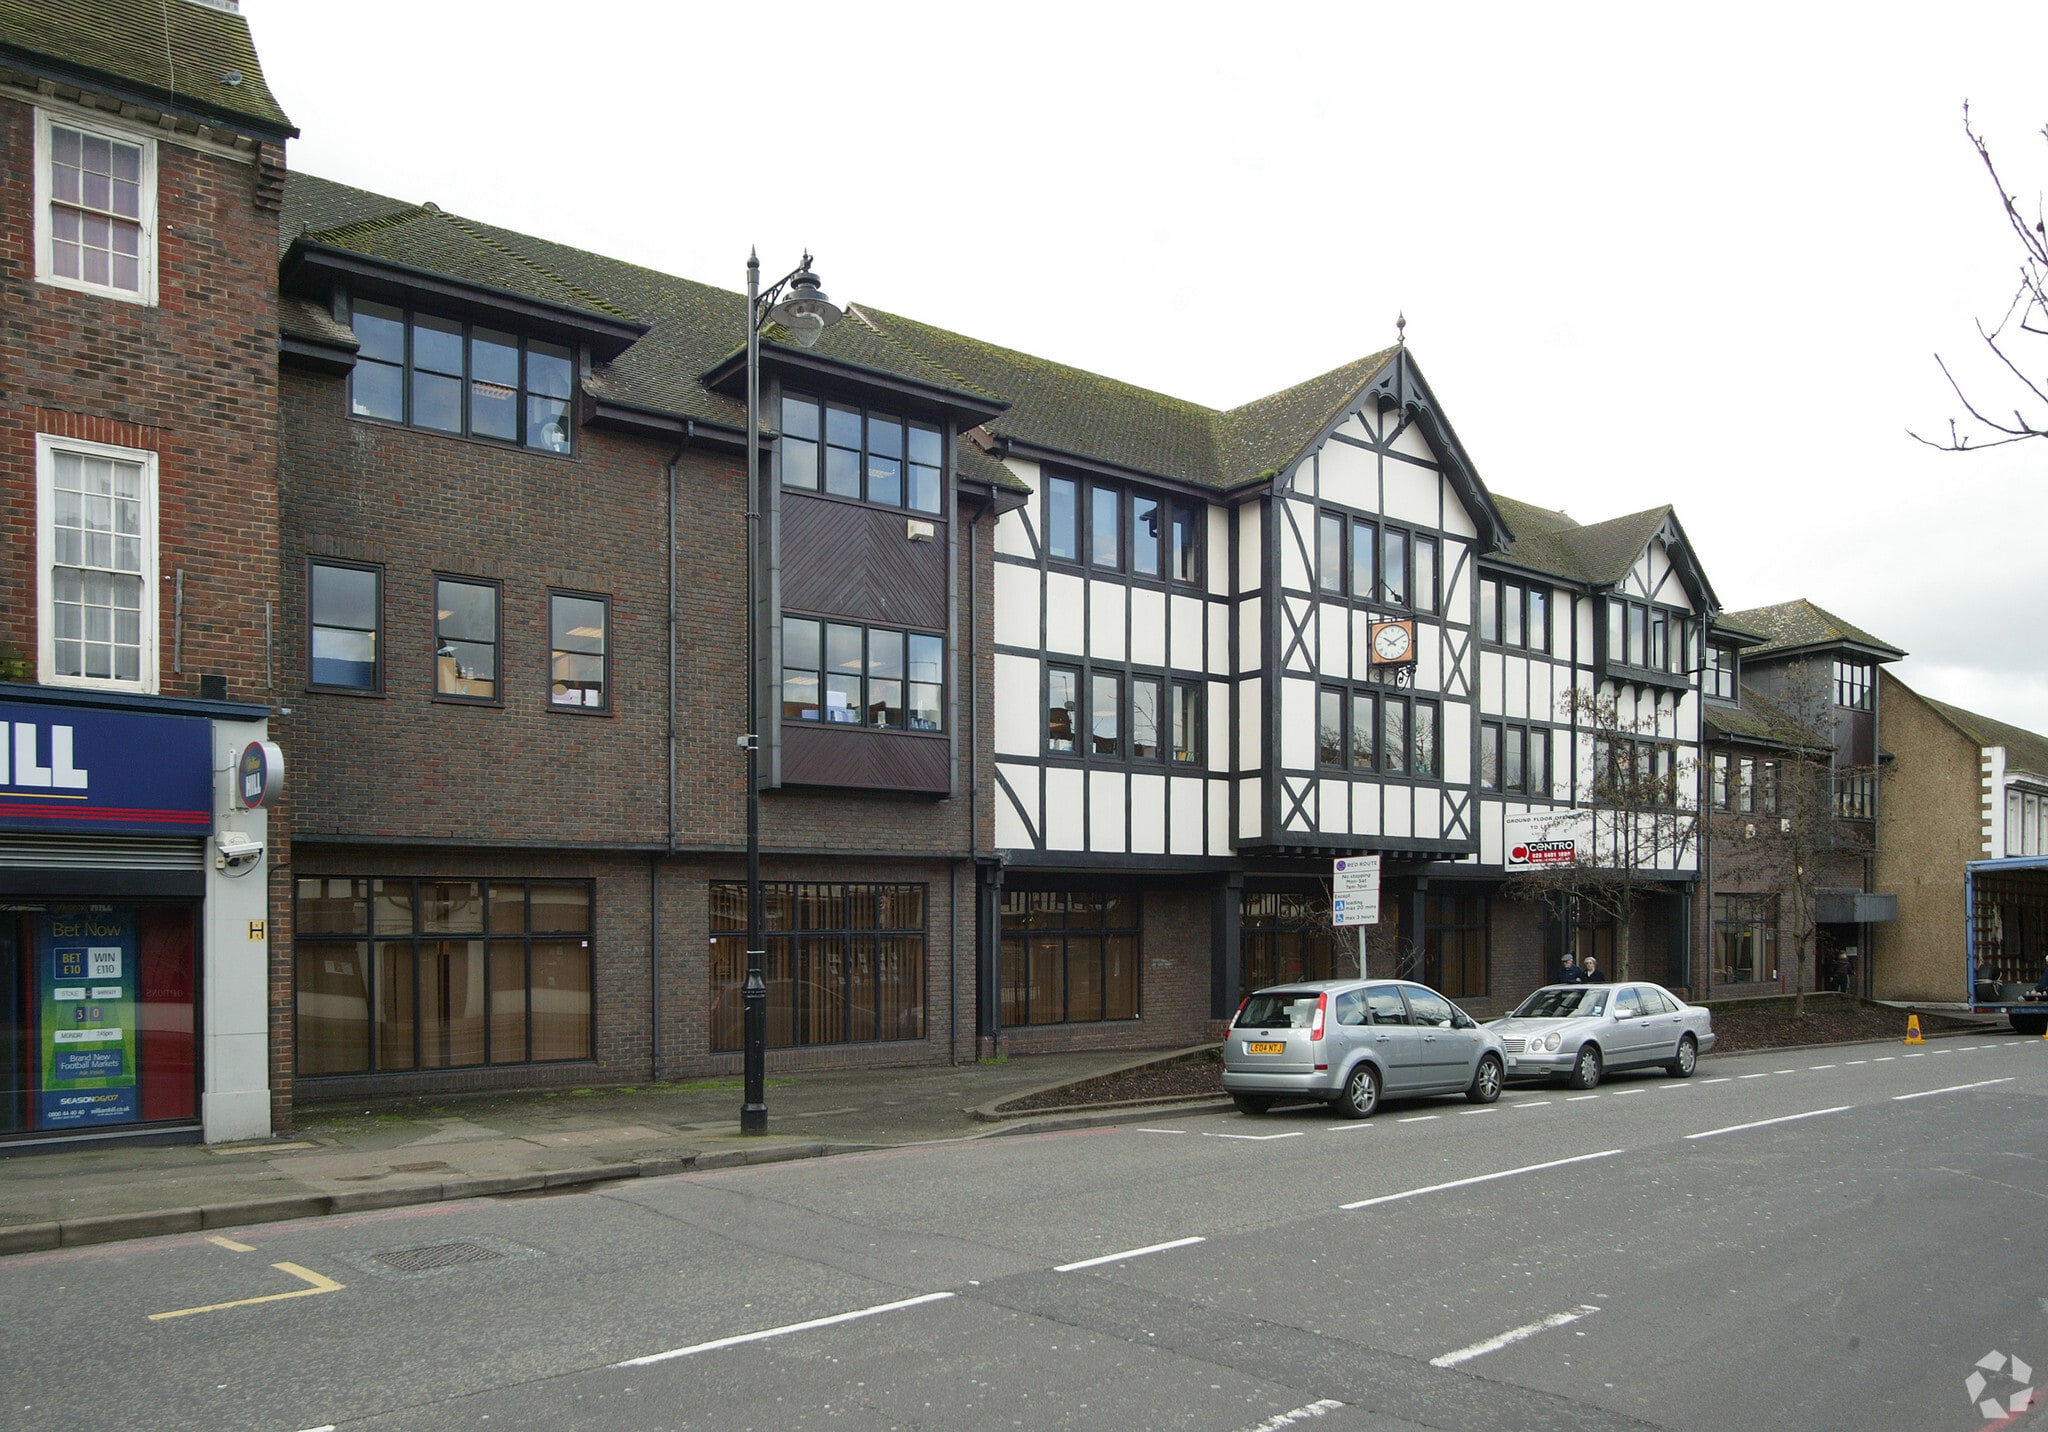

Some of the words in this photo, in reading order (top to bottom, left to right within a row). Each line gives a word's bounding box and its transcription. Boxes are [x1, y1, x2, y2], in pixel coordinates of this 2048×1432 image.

[245, 772, 262, 798] HILL
[53, 922, 80, 937] Bet
[84, 921, 121, 937] Now
[249, 921, 264, 939] H
[62, 953, 81, 963] BET
[94, 953, 116, 962] WIN
[63, 965, 81, 974] £10
[96, 964, 115, 974] £110
[77, 1009, 84, 1020] 3
[92, 1008, 99, 1018] 0
[69, 1054, 92, 1062] Brand
[93, 1053, 111, 1061] New
[60, 1062, 89, 1070] Football
[91, 1060, 119, 1068] Markets
